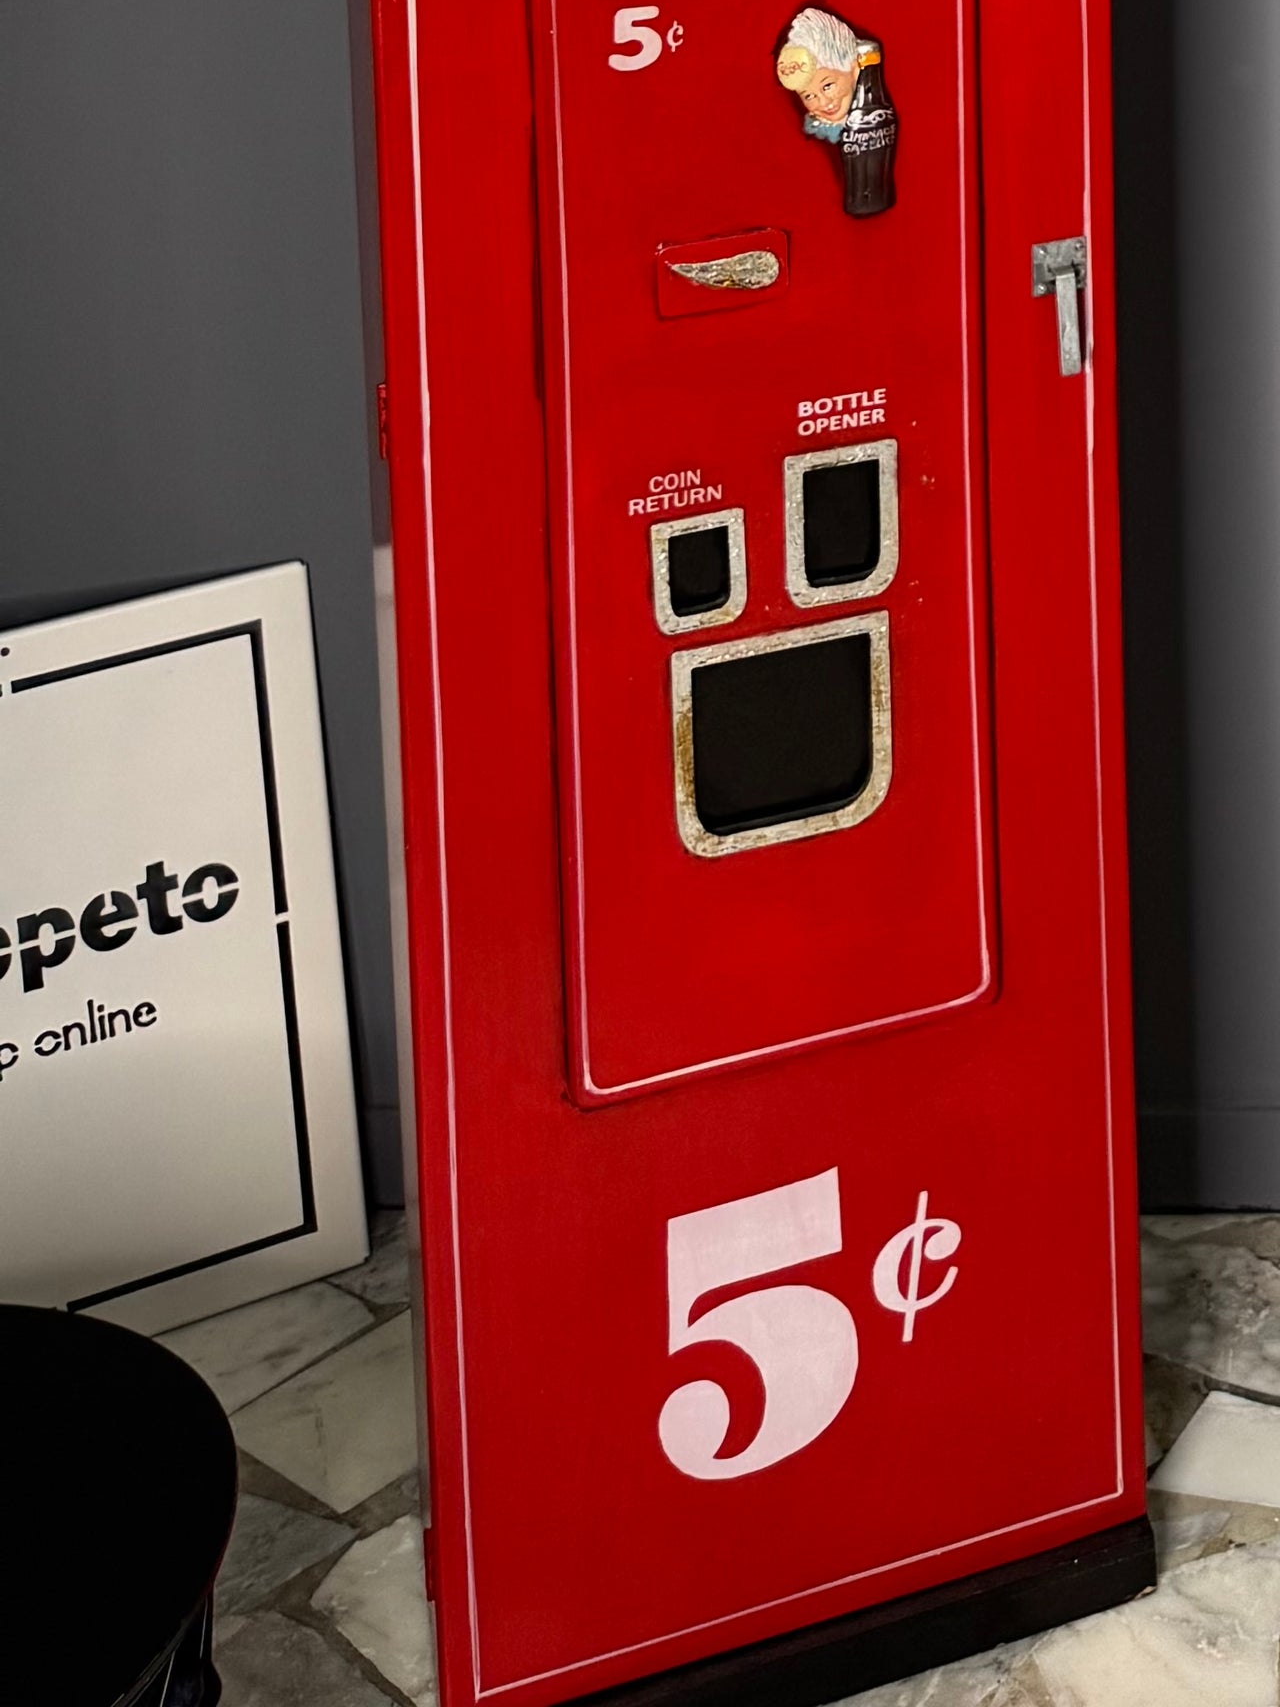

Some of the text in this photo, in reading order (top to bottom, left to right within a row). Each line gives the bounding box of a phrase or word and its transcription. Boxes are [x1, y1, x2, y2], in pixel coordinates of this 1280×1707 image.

[797, 387, 888, 419] BOTTLE
[797, 407, 887, 437] OPENER
[647, 468, 702, 493] COIN
[627, 484, 723, 517] RETURN
[0, 861, 240, 993] peto
[34, 999, 158, 1057] online
